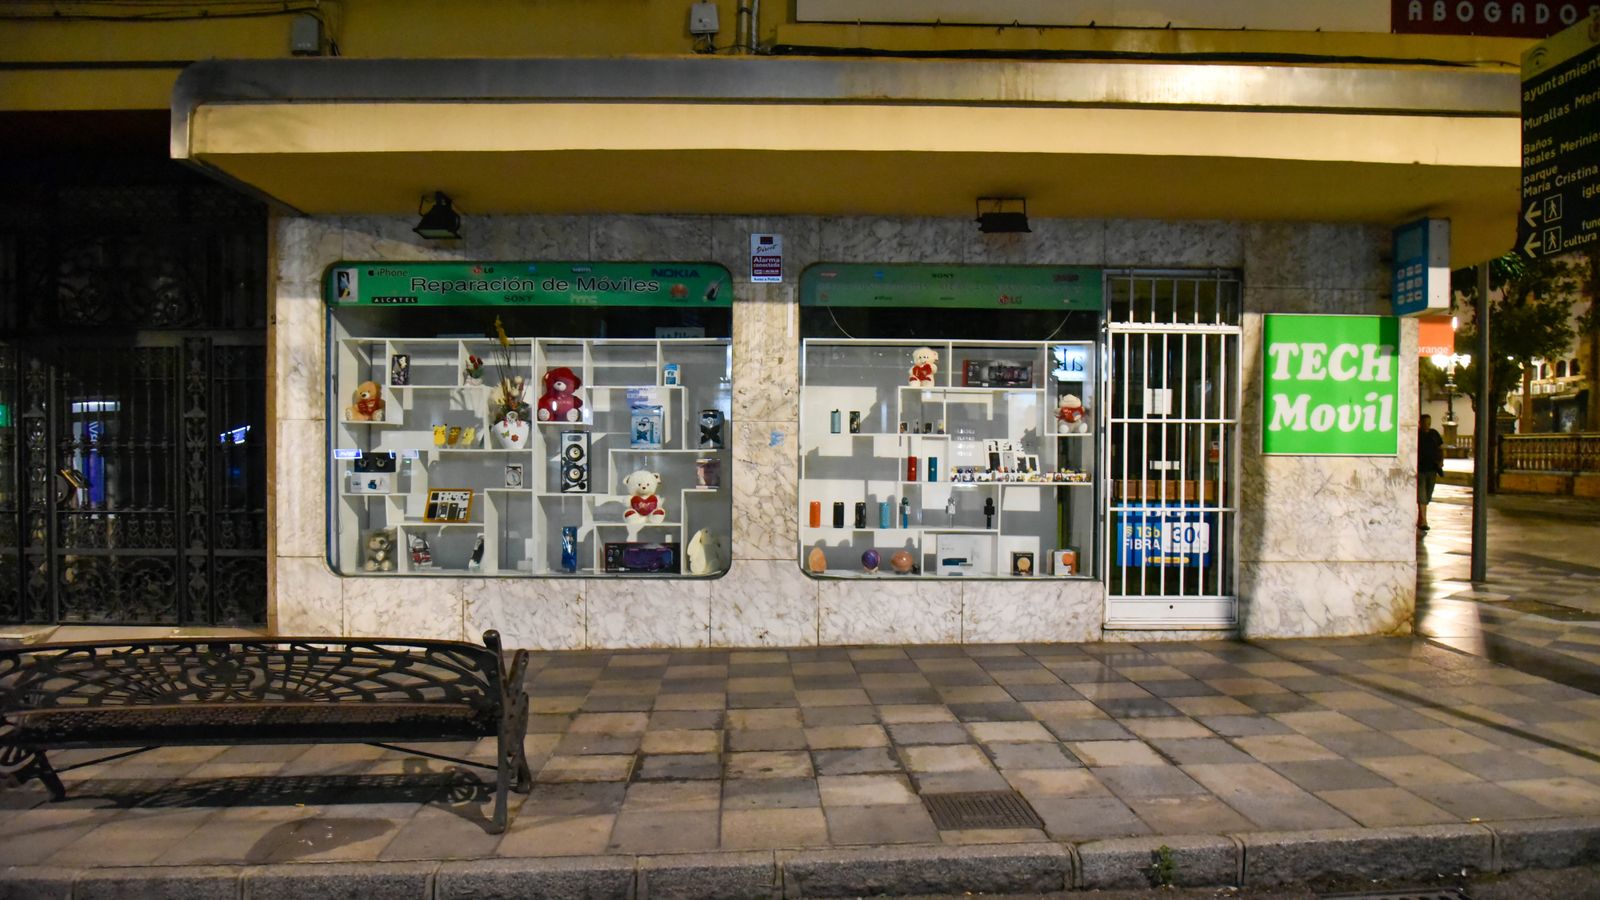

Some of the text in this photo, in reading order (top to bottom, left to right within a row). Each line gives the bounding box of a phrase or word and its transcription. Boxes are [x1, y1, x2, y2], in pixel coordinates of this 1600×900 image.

[1523, 103, 1570, 132] Murallas
[1524, 148, 1556, 169] Reales
[1524, 165, 1559, 188] parque
[1555, 164, 1599, 187] Cristina
[1563, 232, 1598, 248] cultura
[652, 268, 699, 278] NOKIA
[411, 276, 660, 294] Reparación de Móviles
[1268, 342, 1395, 382] TECH
[1268, 392, 1394, 433] Movil
